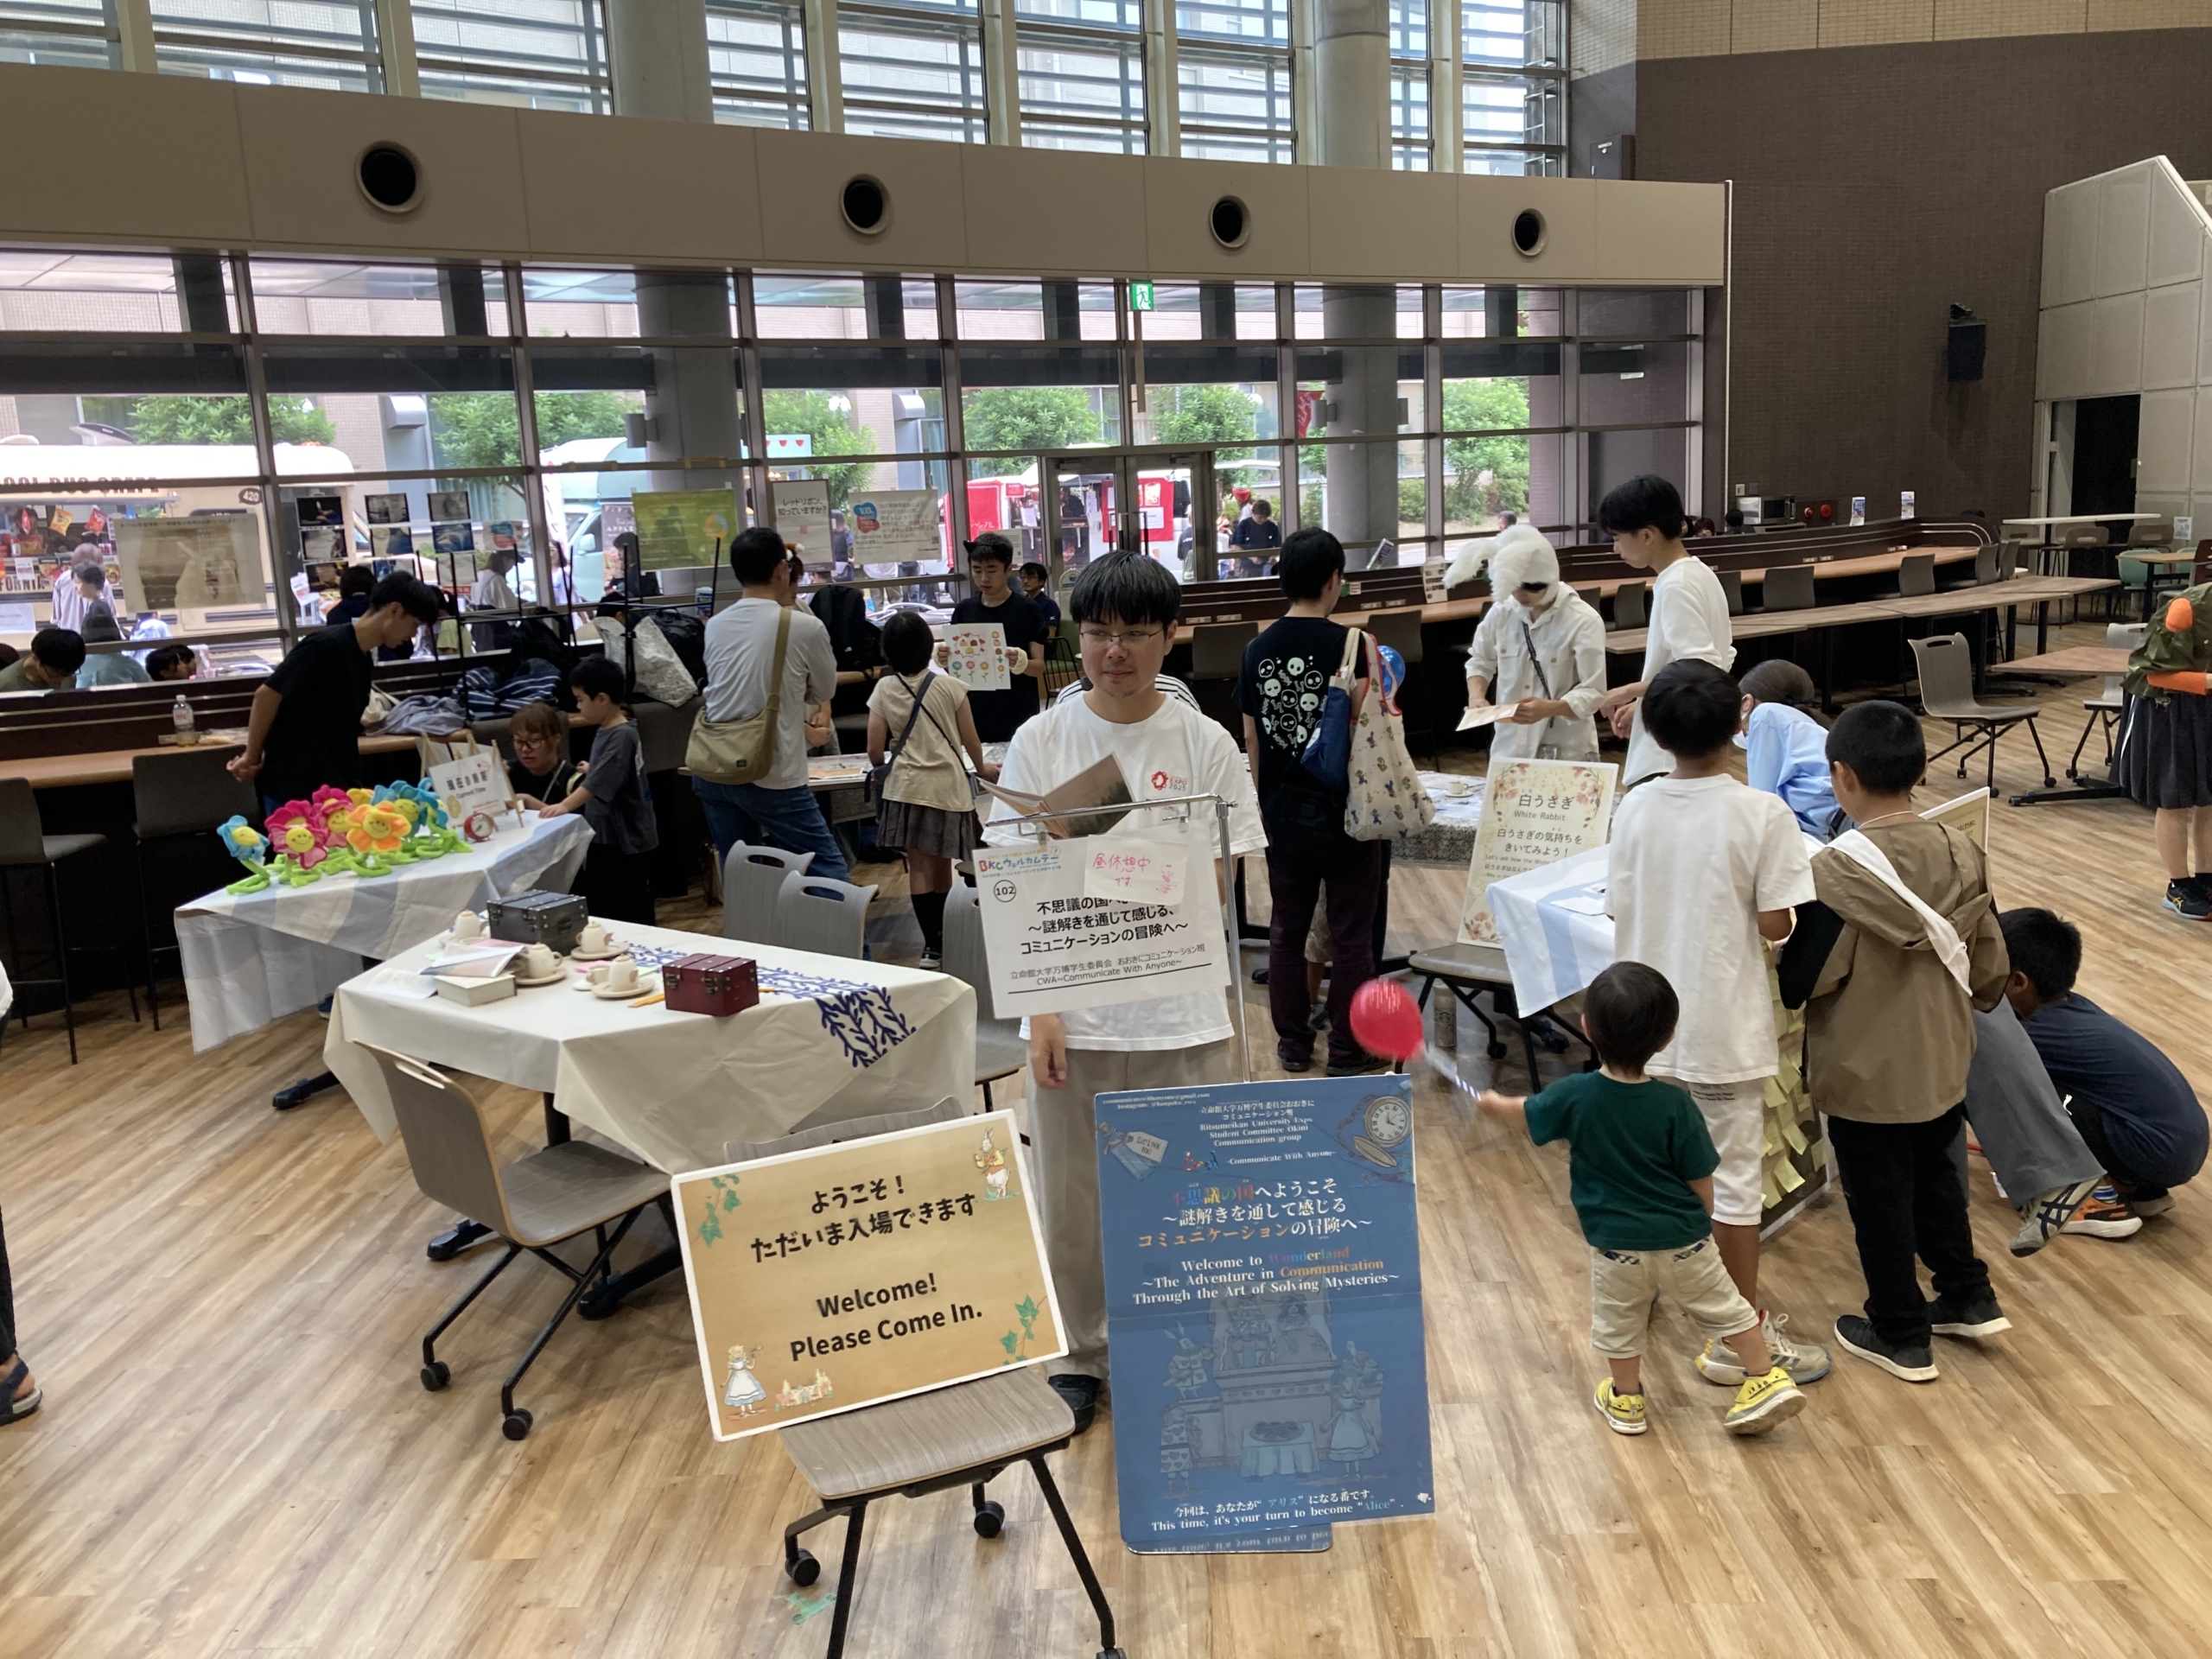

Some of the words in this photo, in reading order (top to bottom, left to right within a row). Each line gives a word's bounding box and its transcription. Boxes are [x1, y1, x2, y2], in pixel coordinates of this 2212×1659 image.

[243, 490, 259, 502] 420
[1168, 783, 1186, 792] 2025
[1169, 777, 1187, 786] EXPO
[1519, 793, 1574, 810] 白うさぎ
[1514, 810, 1537, 819] White
[1540, 811, 1566, 822] Rabbit
[1497, 829, 1582, 845] 白うさぎの気持ちを
[1092, 852, 1152, 874] 昼休憩中
[995, 886, 1016, 897] 102
[1010, 959, 1113, 981] 立命館大学万博学生委員会
[1123, 962, 1144, 975] With
[1199, 1121, 1249, 1131] Ritsumeikan
[1251, 1117, 1292, 1128] University
[1210, 1130, 1240, 1139] Student
[1243, 1127, 1285, 1137] Committee
[1287, 1124, 1309, 1133] Okini
[1214, 1135, 1276, 1147] Communication
[1278, 1134, 1302, 1144] group
[1284, 1152, 1303, 1160] With
[810, 1175, 906, 1215] ようこそ！
[1172, 1177, 1338, 1206] 不思議の国へようこそ
[750, 1192, 976, 1264] ただいま入場できます
[1181, 1256, 1244, 1272] Welcome
[1249, 1255, 1263, 1267] to
[1268, 1246, 1351, 1264] Wonderland
[1185, 1271, 1256, 1287] Adventure
[1261, 1268, 1274, 1280] in
[1279, 1259, 1385, 1279] Communication
[817, 1272, 938, 1319] Welcome!
[1133, 1291, 1192, 1306] Through
[1197, 1287, 1219, 1300] the
[1225, 1283, 1246, 1297] Art
[1252, 1281, 1266, 1294] of
[1270, 1276, 1320, 1294] Solving
[790, 1328, 873, 1363] Please
[876, 1312, 946, 1341] Come
[951, 1301, 983, 1324] In.
[1152, 1519, 1176, 1532] This
[1180, 1516, 1210, 1530] time,
[1213, 1514, 1230, 1527] it's
[1234, 1512, 1262, 1527] your
[1266, 1510, 1290, 1522] turn
[1294, 1508, 1306, 1519] to
[1311, 1503, 1354, 1517] become
